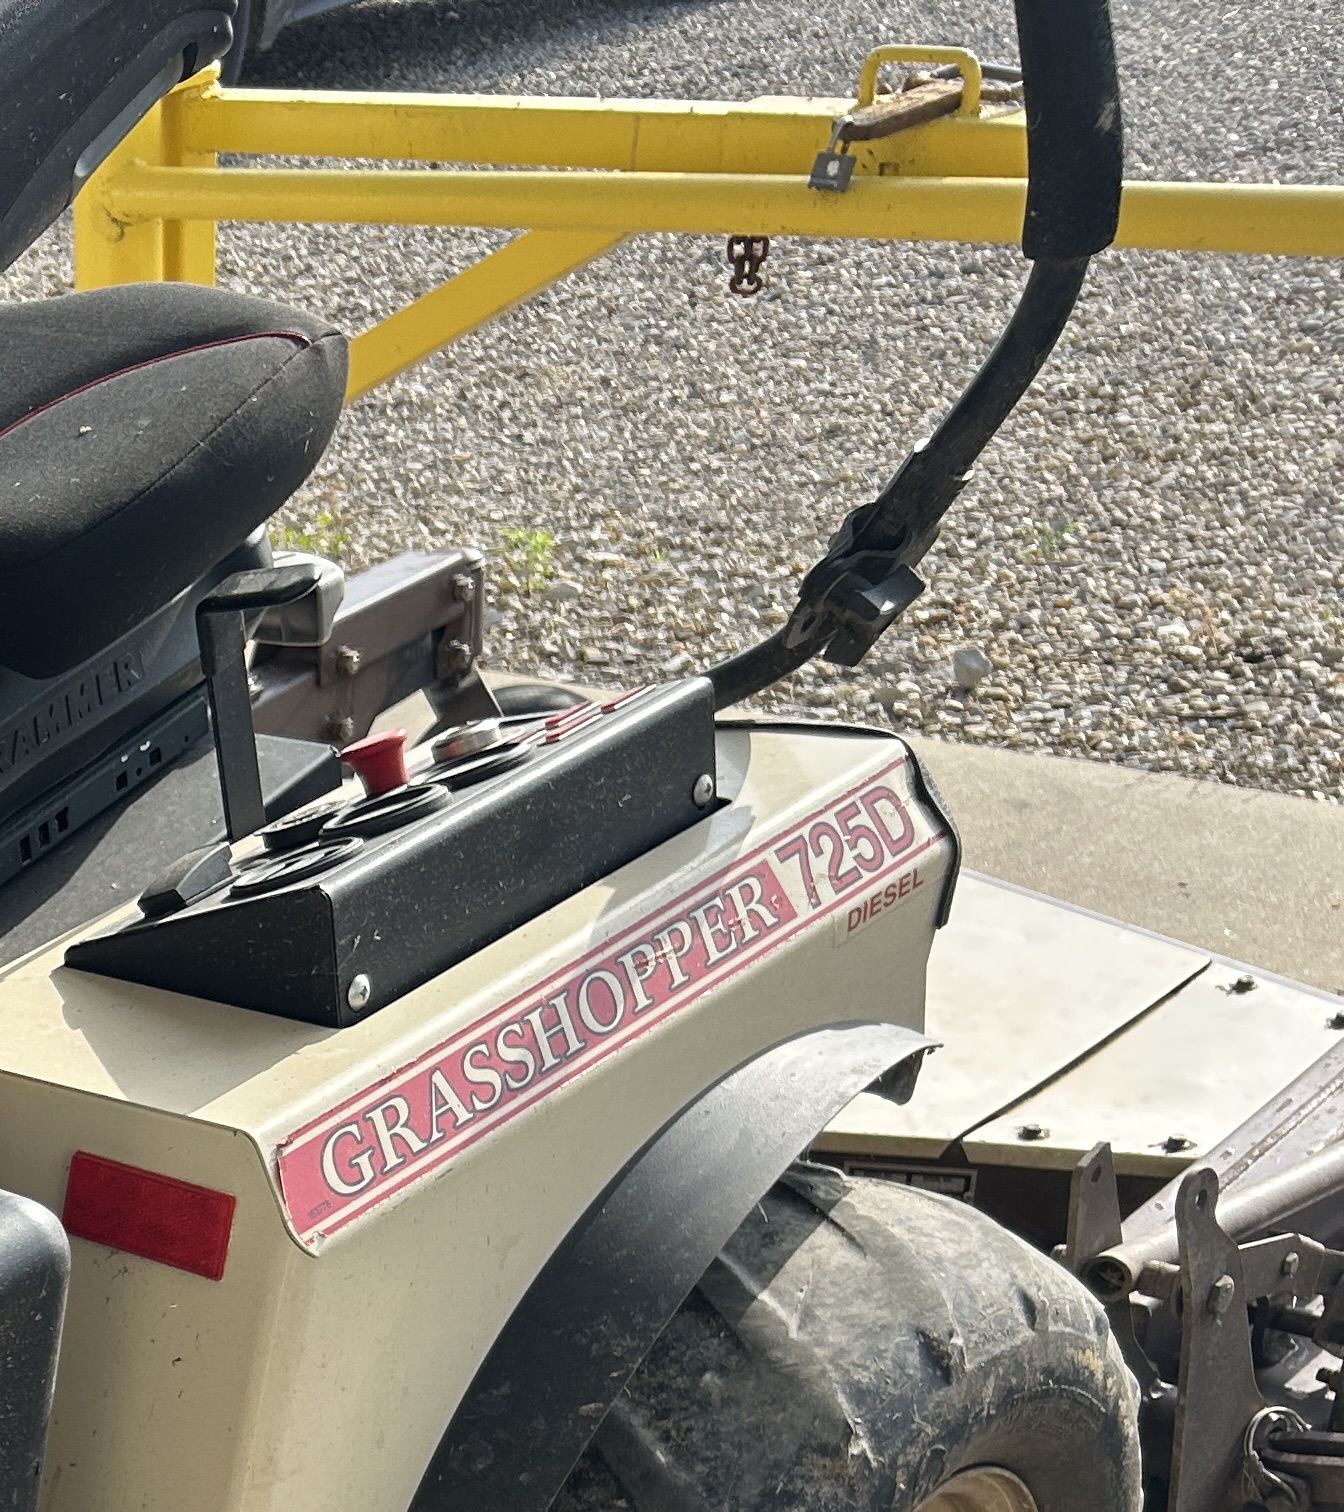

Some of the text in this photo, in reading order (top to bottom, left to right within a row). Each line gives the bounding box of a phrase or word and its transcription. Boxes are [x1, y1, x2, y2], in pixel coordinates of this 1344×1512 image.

[320, 785, 916, 1199] GRASSHOPPER 725D
[847, 868, 924, 933] DIESEL
